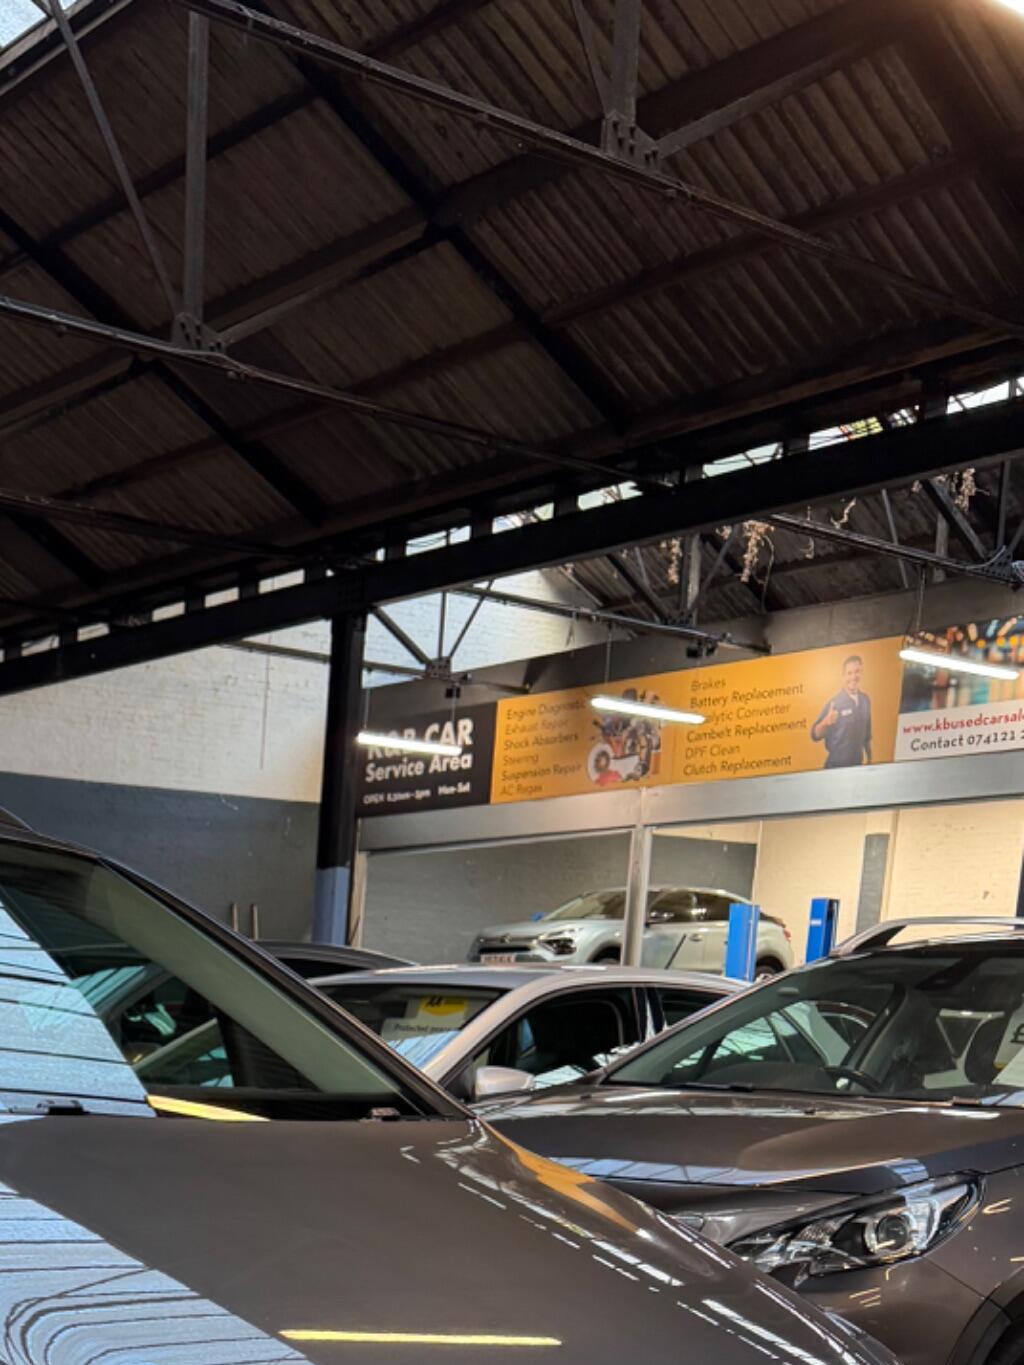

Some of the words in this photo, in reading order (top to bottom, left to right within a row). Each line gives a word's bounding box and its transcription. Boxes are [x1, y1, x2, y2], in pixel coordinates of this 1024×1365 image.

[690, 694, 728, 708] Battery
[731, 684, 804, 704] Replacement
[691, 679, 726, 692] Brakes
[506, 708, 536, 721] Engine
[737, 704, 791, 720] Converter
[424, 718, 474, 749] CAR
[687, 726, 732, 743] Cambelt
[735, 718, 807, 738] Replacement
[910, 730, 964, 752] Contact
[504, 738, 529, 751] Shock
[532, 732, 578, 747] Absorbers
[685, 746, 707, 760] DPF
[710, 743, 740, 757] Clean
[365, 758, 425, 783] Service
[428, 753, 473, 774] Area
[503, 753, 539, 767] Steering
[683, 763, 717, 777] Clutch
[720, 755, 792, 773] Replacement
[502, 767, 551, 783] Suspension
[553, 762, 582, 776] Repair
